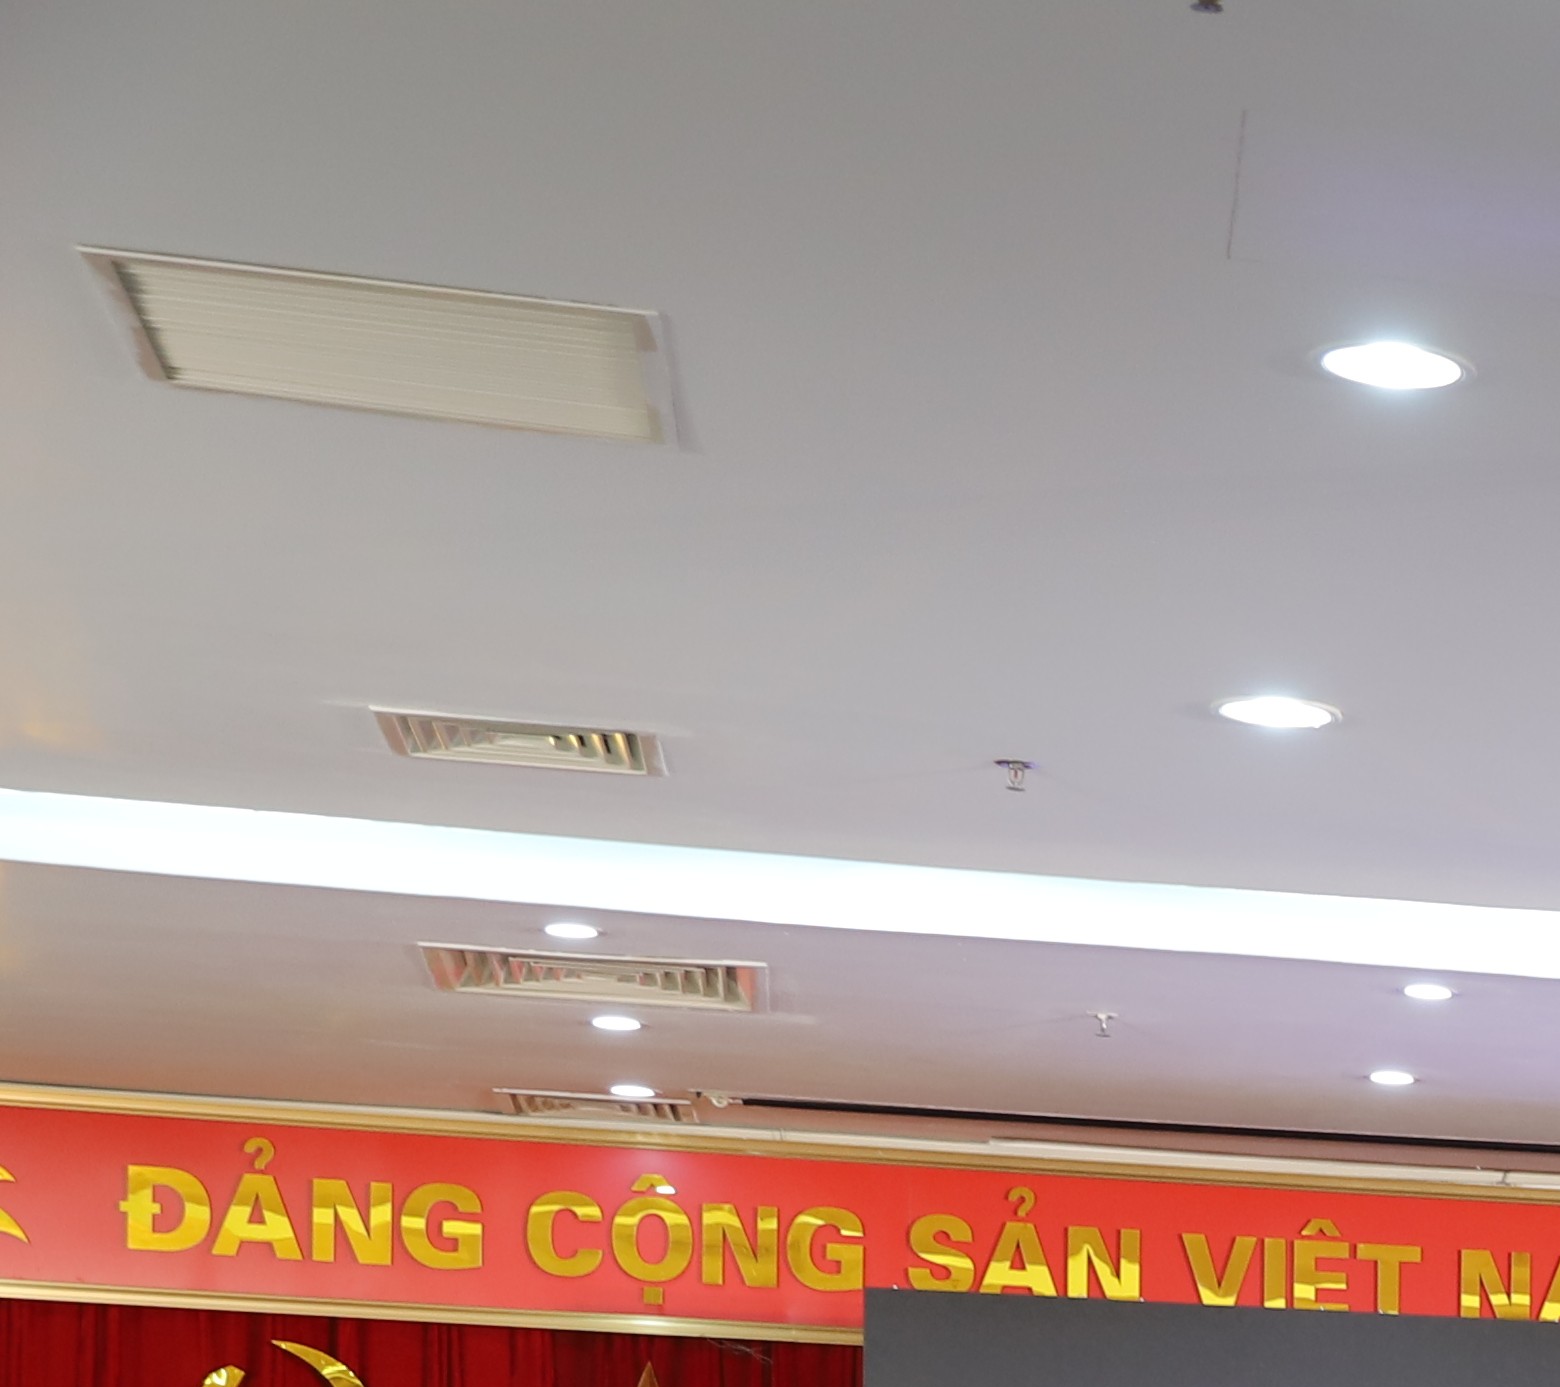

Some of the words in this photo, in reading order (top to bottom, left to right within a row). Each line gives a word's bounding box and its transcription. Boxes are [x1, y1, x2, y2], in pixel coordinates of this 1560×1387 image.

[120, 1136, 485, 1270] ĐẢNG
[526, 1173, 865, 1305] CỘNG
[906, 1186, 1142, 1302] SẢN
